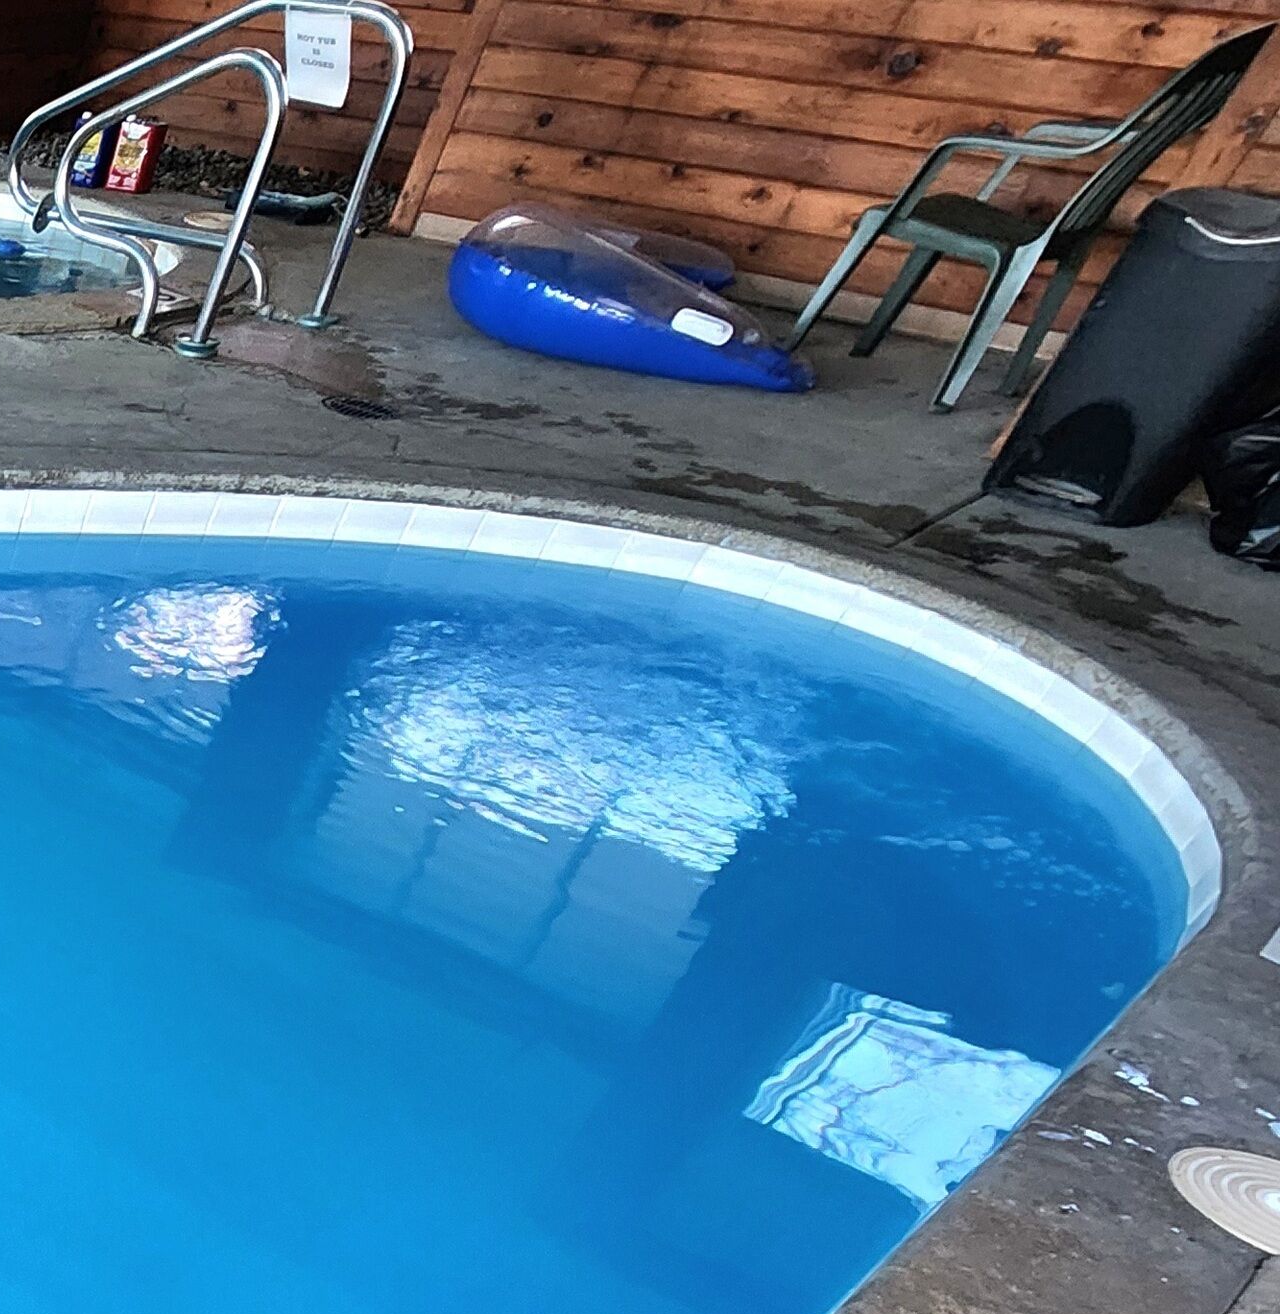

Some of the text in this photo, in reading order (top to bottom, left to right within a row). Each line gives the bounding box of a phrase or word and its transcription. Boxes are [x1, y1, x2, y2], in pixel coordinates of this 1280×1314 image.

[297, 33, 336, 45] HOT TUB
[301, 57, 335, 69] CLOSED
